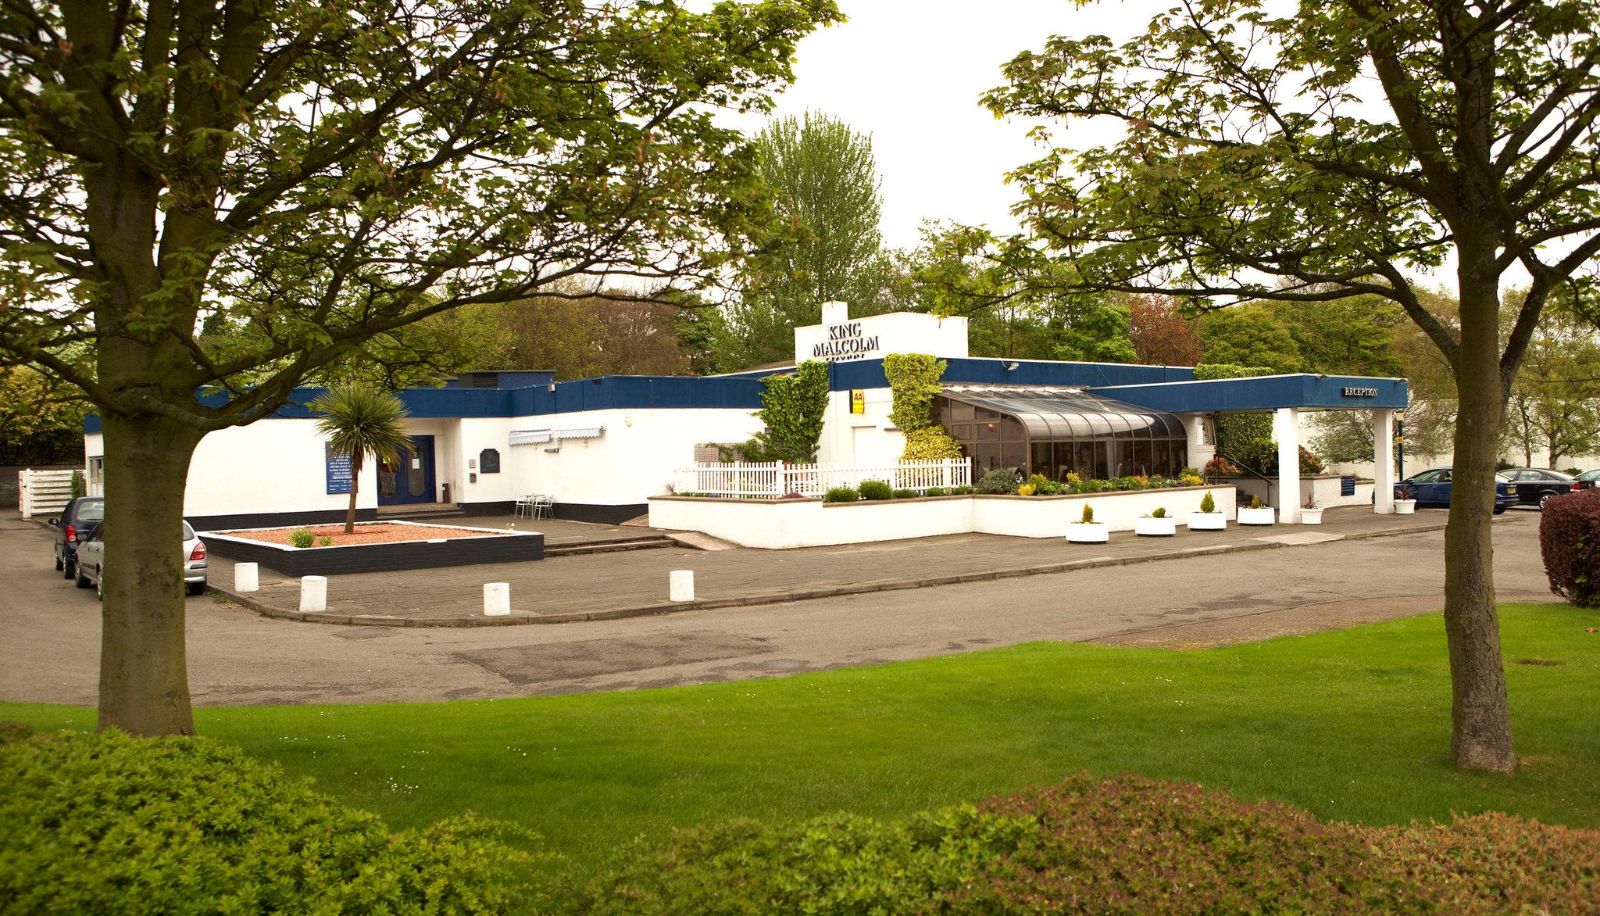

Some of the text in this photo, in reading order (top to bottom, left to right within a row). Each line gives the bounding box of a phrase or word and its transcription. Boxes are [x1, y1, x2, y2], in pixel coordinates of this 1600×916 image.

[829, 322, 861, 340] KING
[813, 336, 879, 357] MALCOLM
[1344, 387, 1379, 397] RECEPTION
